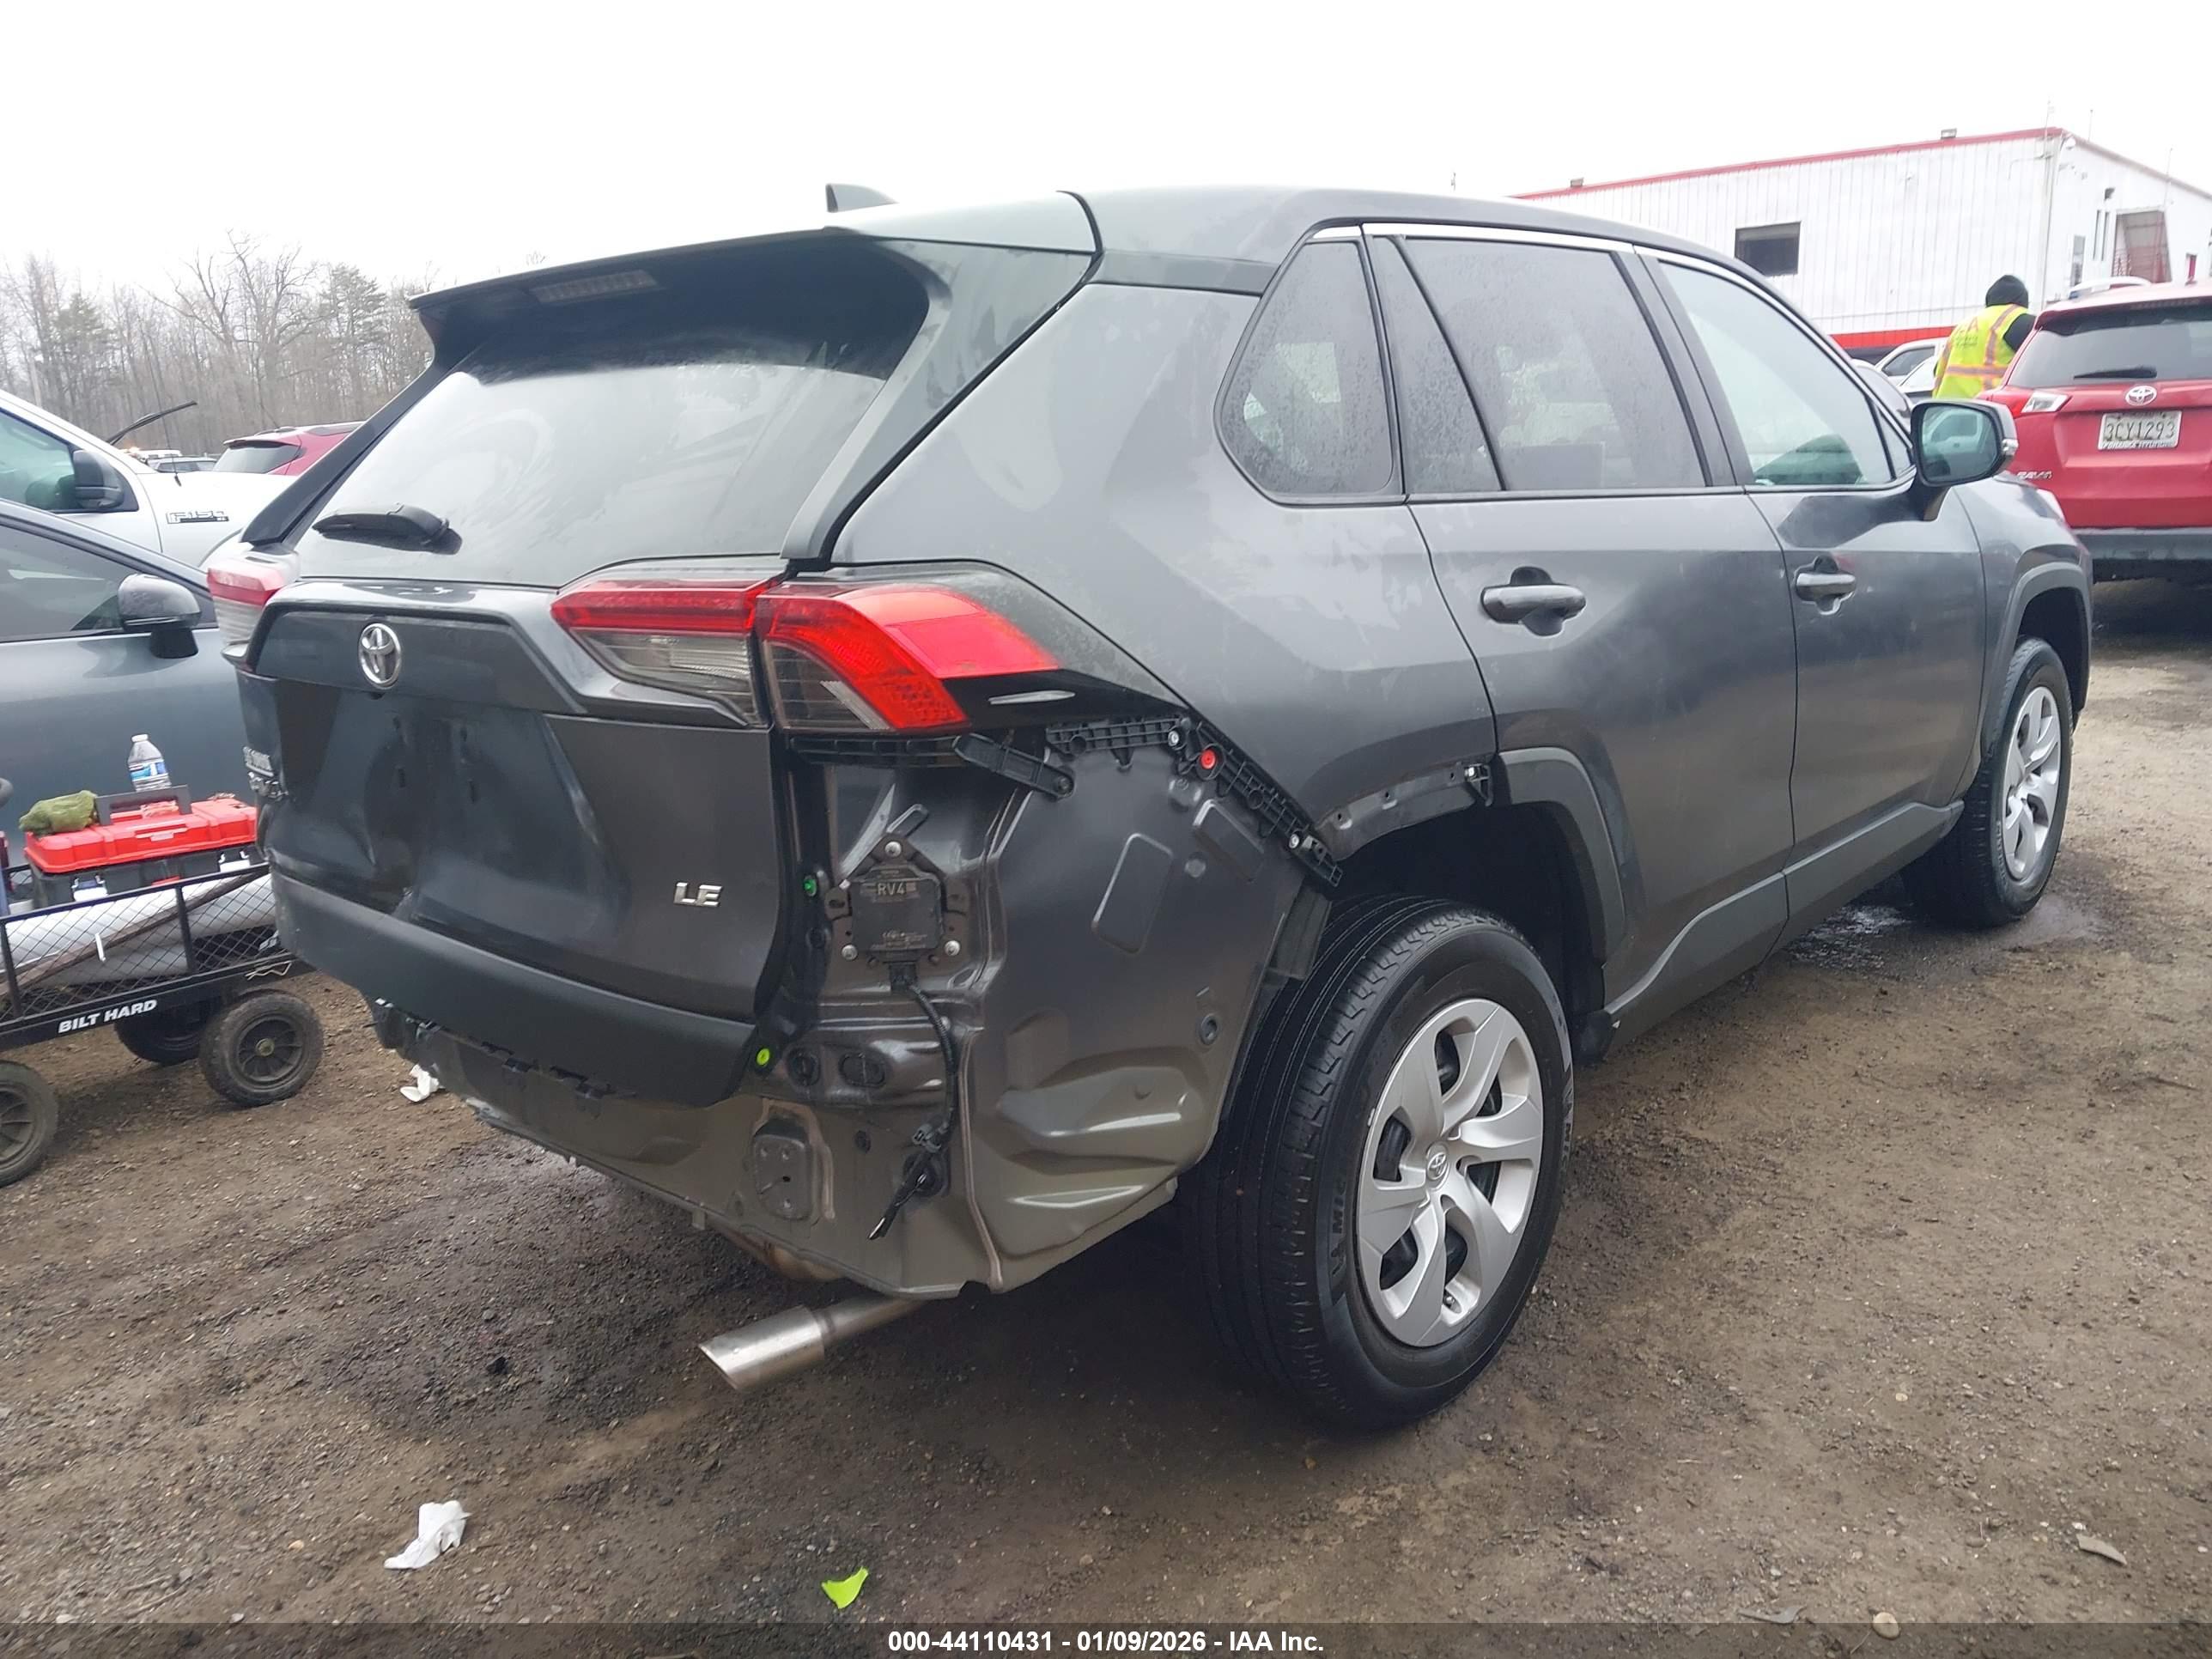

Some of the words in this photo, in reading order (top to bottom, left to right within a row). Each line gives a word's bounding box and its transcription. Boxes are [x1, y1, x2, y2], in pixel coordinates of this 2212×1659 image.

[2105, 420, 2176, 441] 3CY1293
[673, 882, 723, 907] LE
[877, 881, 906, 896] RV4
[58, 1012, 101, 1034] BILT
[103, 1000, 157, 1022] HARD
